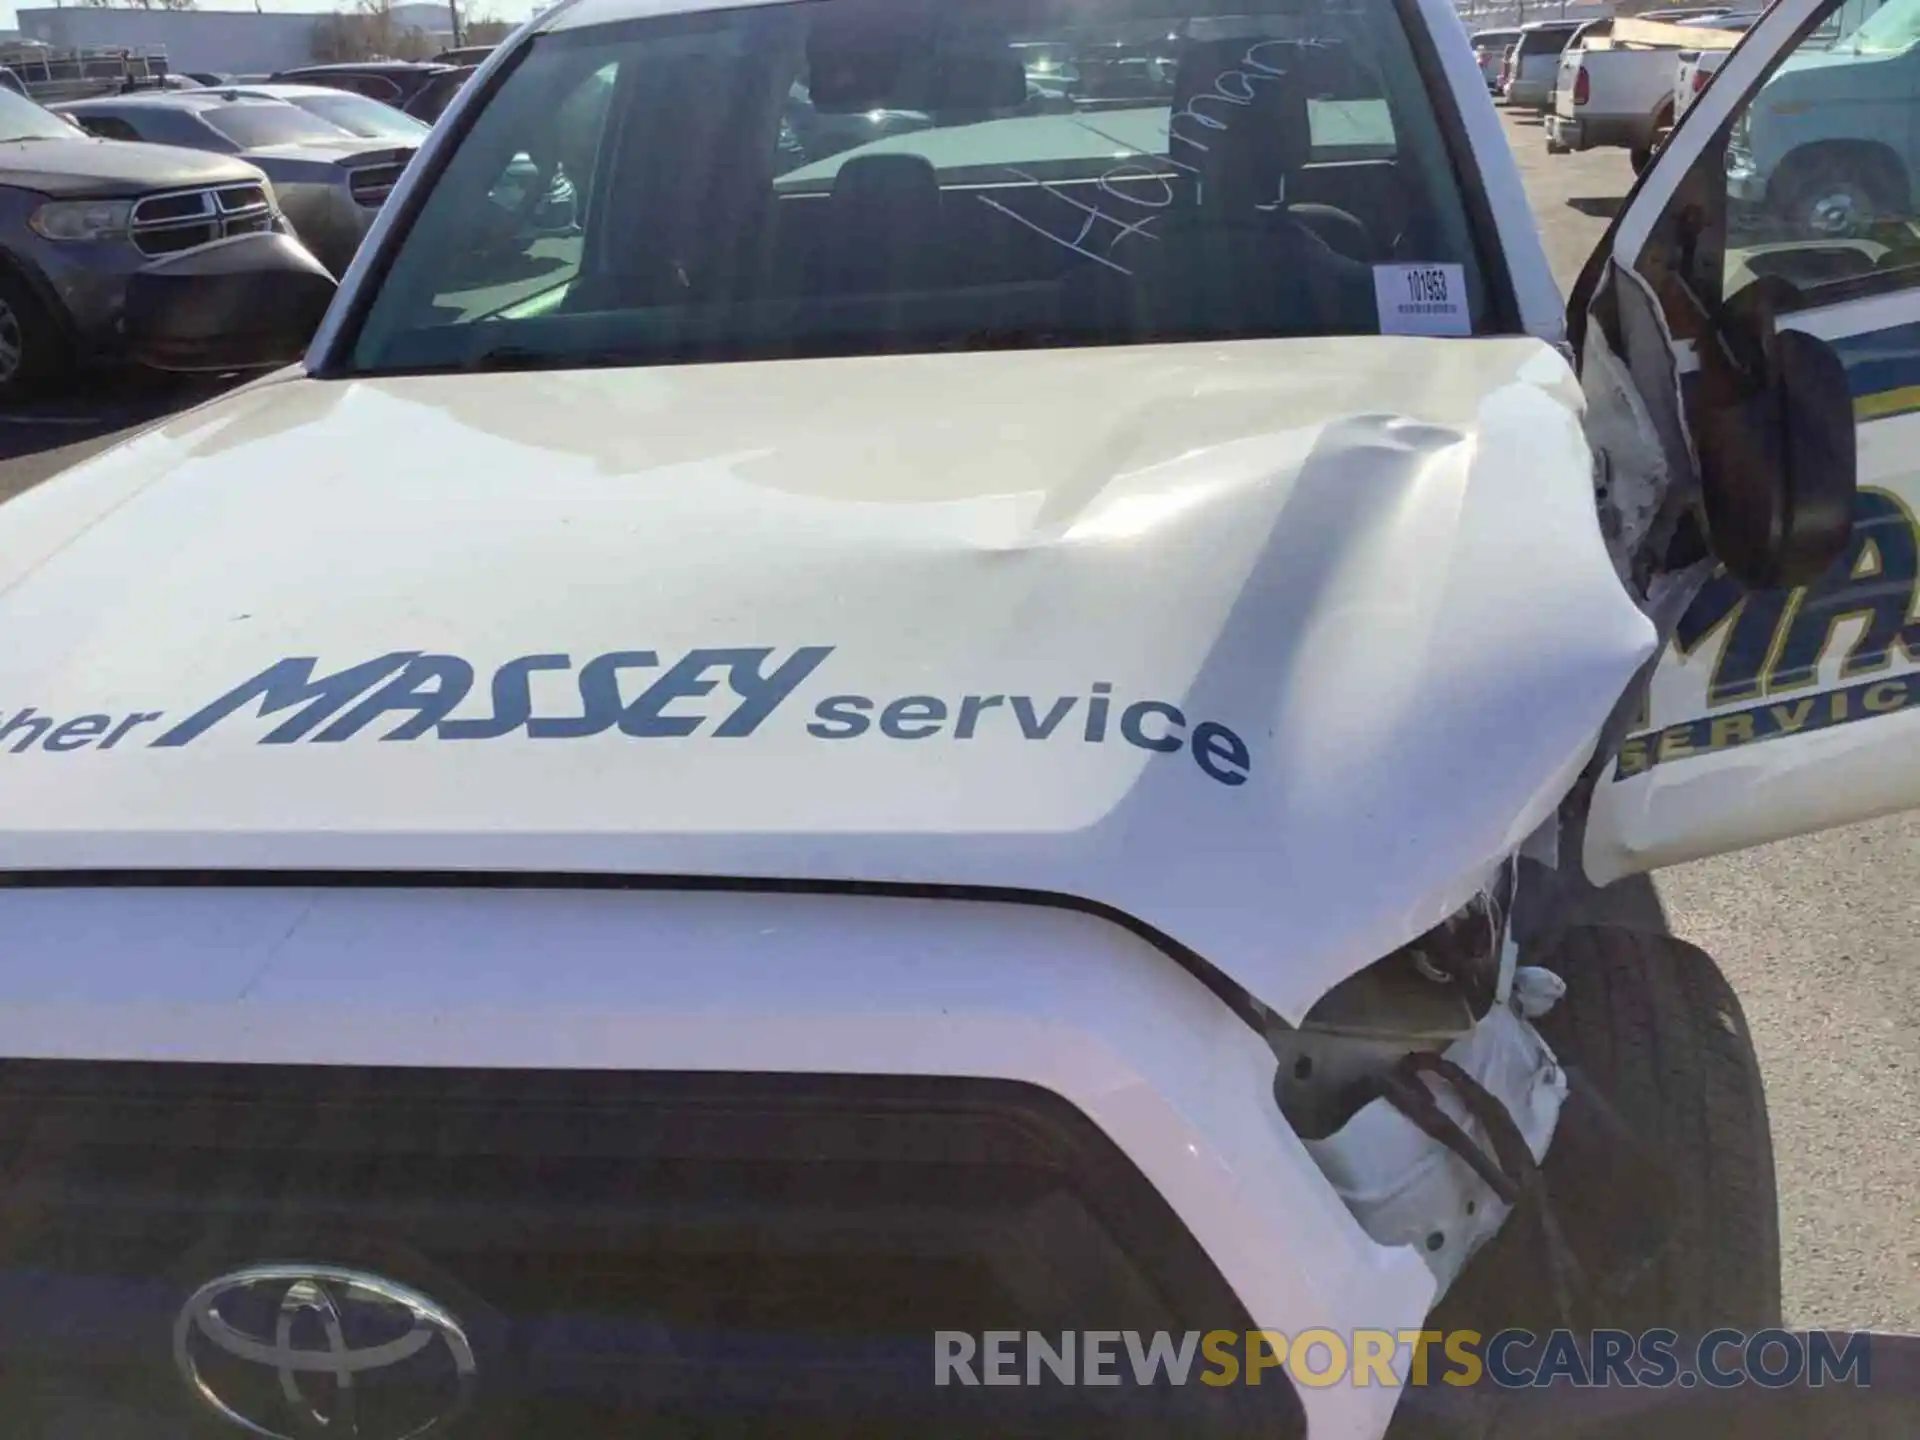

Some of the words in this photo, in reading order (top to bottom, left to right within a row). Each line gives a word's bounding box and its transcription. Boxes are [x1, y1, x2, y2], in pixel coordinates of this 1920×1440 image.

[1407, 269, 1447, 301] 101953
[0, 706, 165, 754] her
[147, 645, 837, 748] MASSEY
[806, 682, 1251, 787] service
